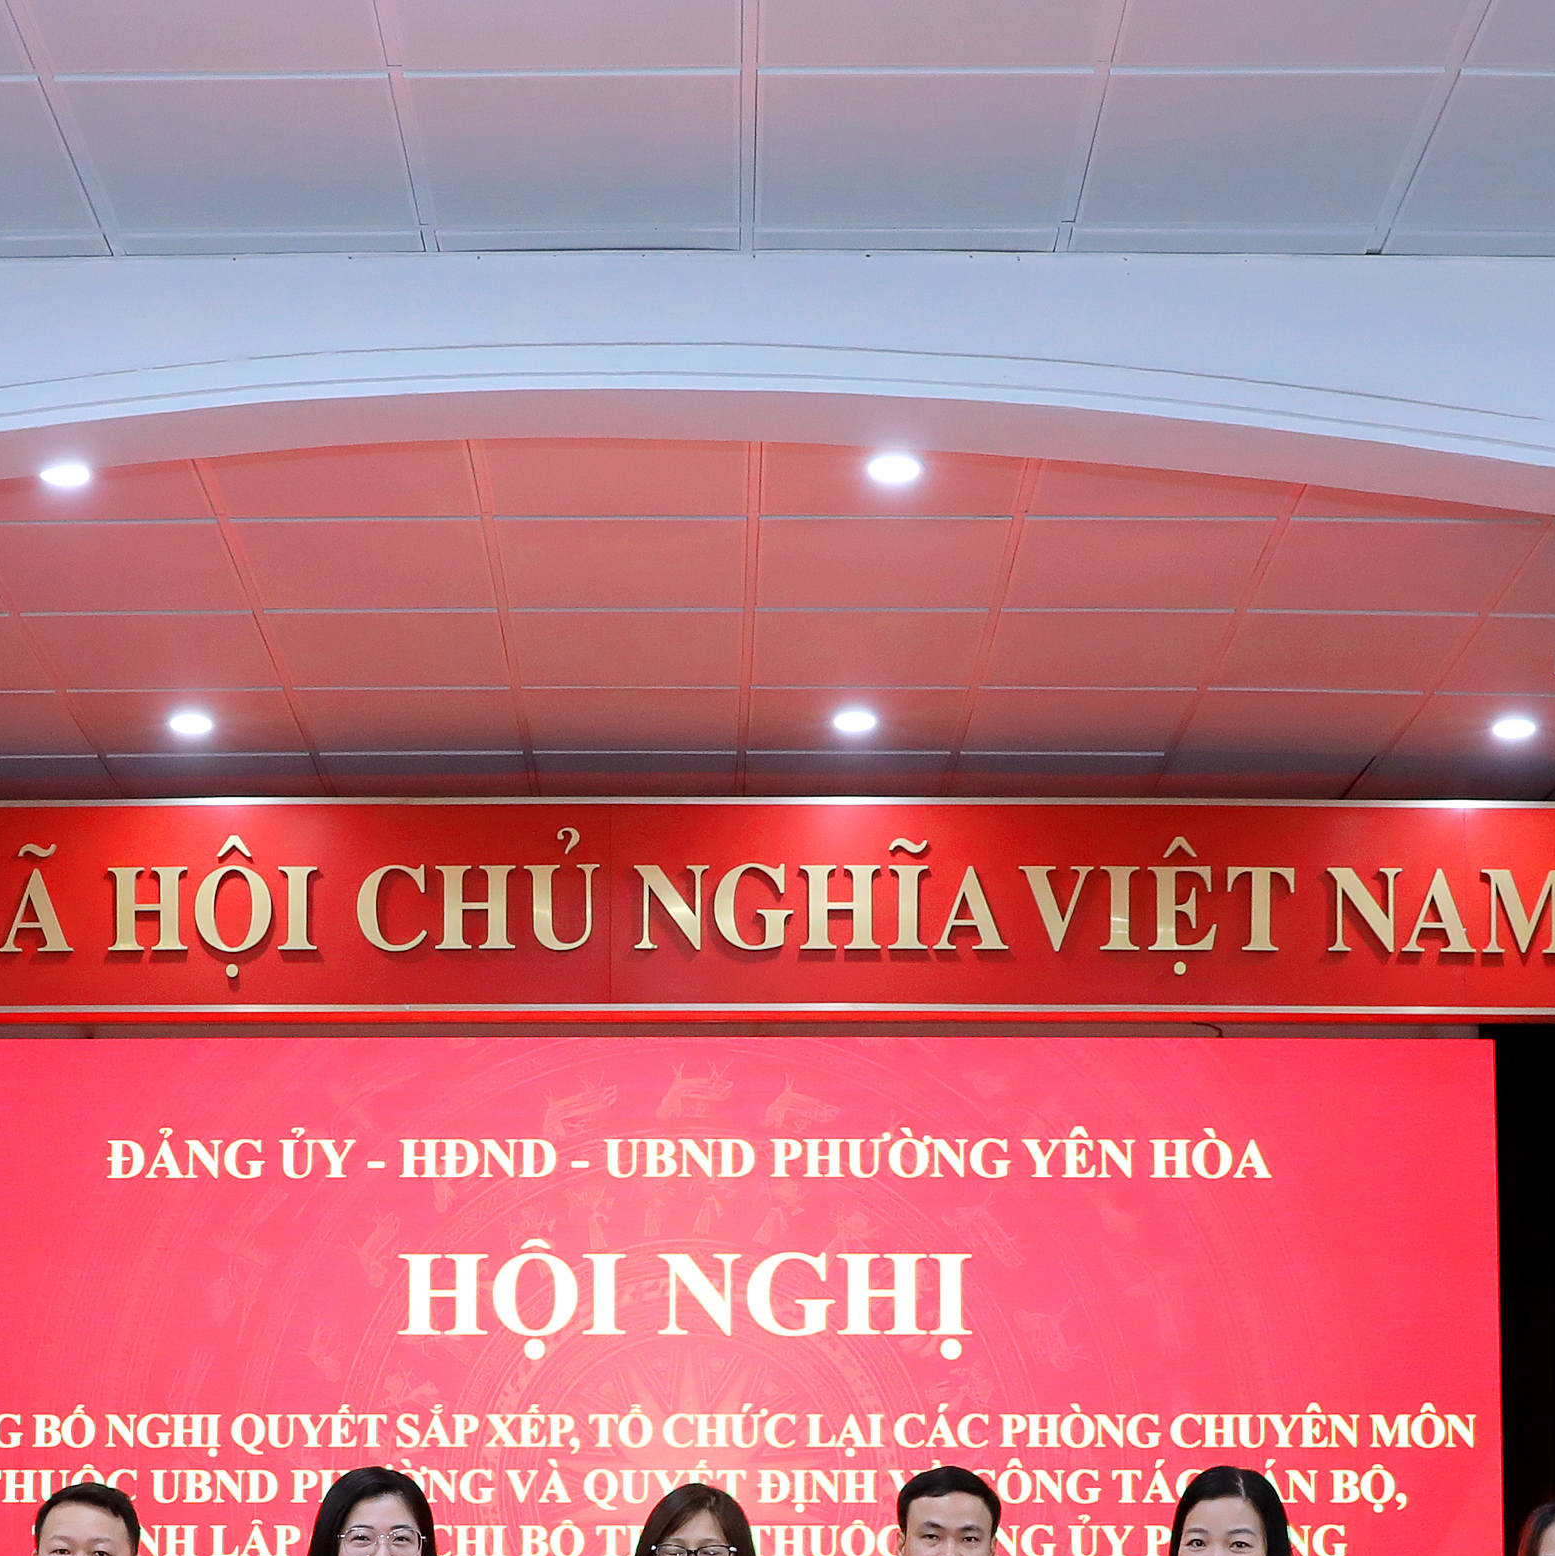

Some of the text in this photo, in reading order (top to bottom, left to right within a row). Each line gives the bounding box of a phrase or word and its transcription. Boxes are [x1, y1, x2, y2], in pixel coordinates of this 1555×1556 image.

[108, 835, 317, 978] HỘI
[357, 828, 601, 952] CHỦ
[633, 837, 1010, 952] NGHĨA
[1019, 837, 1294, 975] VIỆT
[106, 1127, 265, 1179] ĐẢNG
[279, 1126, 356, 1179] ỦY
[399, 1138, 556, 1179] HĐND
[603, 1138, 755, 1179] UBND
[770, 1126, 1011, 1179] PHƯỜNG
[1022, 1125, 1135, 1178] YÊN
[1150, 1127, 1273, 1179] HÒA
[398, 1239, 973, 1361] HỘI NGHỊ
[33, 1402, 95, 1449] BỐ
[105, 1413, 221, 1458] NGHỊ
[231, 1403, 387, 1456] QUYẾT
[396, 1403, 479, 1449] SẮP
[485, 1403, 580, 1455] XẾP,
[595, 1403, 655, 1449] TỔ
[665, 1408, 796, 1449] CHỨC
[806, 1413, 884, 1458] LẠI
[894, 1403, 988, 1449] CÁC
[999, 1403, 1160, 1449] PHÒNG
[1170, 1402, 1359, 1449] CHUYÊN
[1370, 1402, 1476, 1449] MÔN
[151, 1469, 278, 1504] UBND
[505, 1459, 571, 1504] VÀ
[757, 1469, 877, 1513] ĐỊNH
[1330, 1464, 1407, 1513] BỘ,
